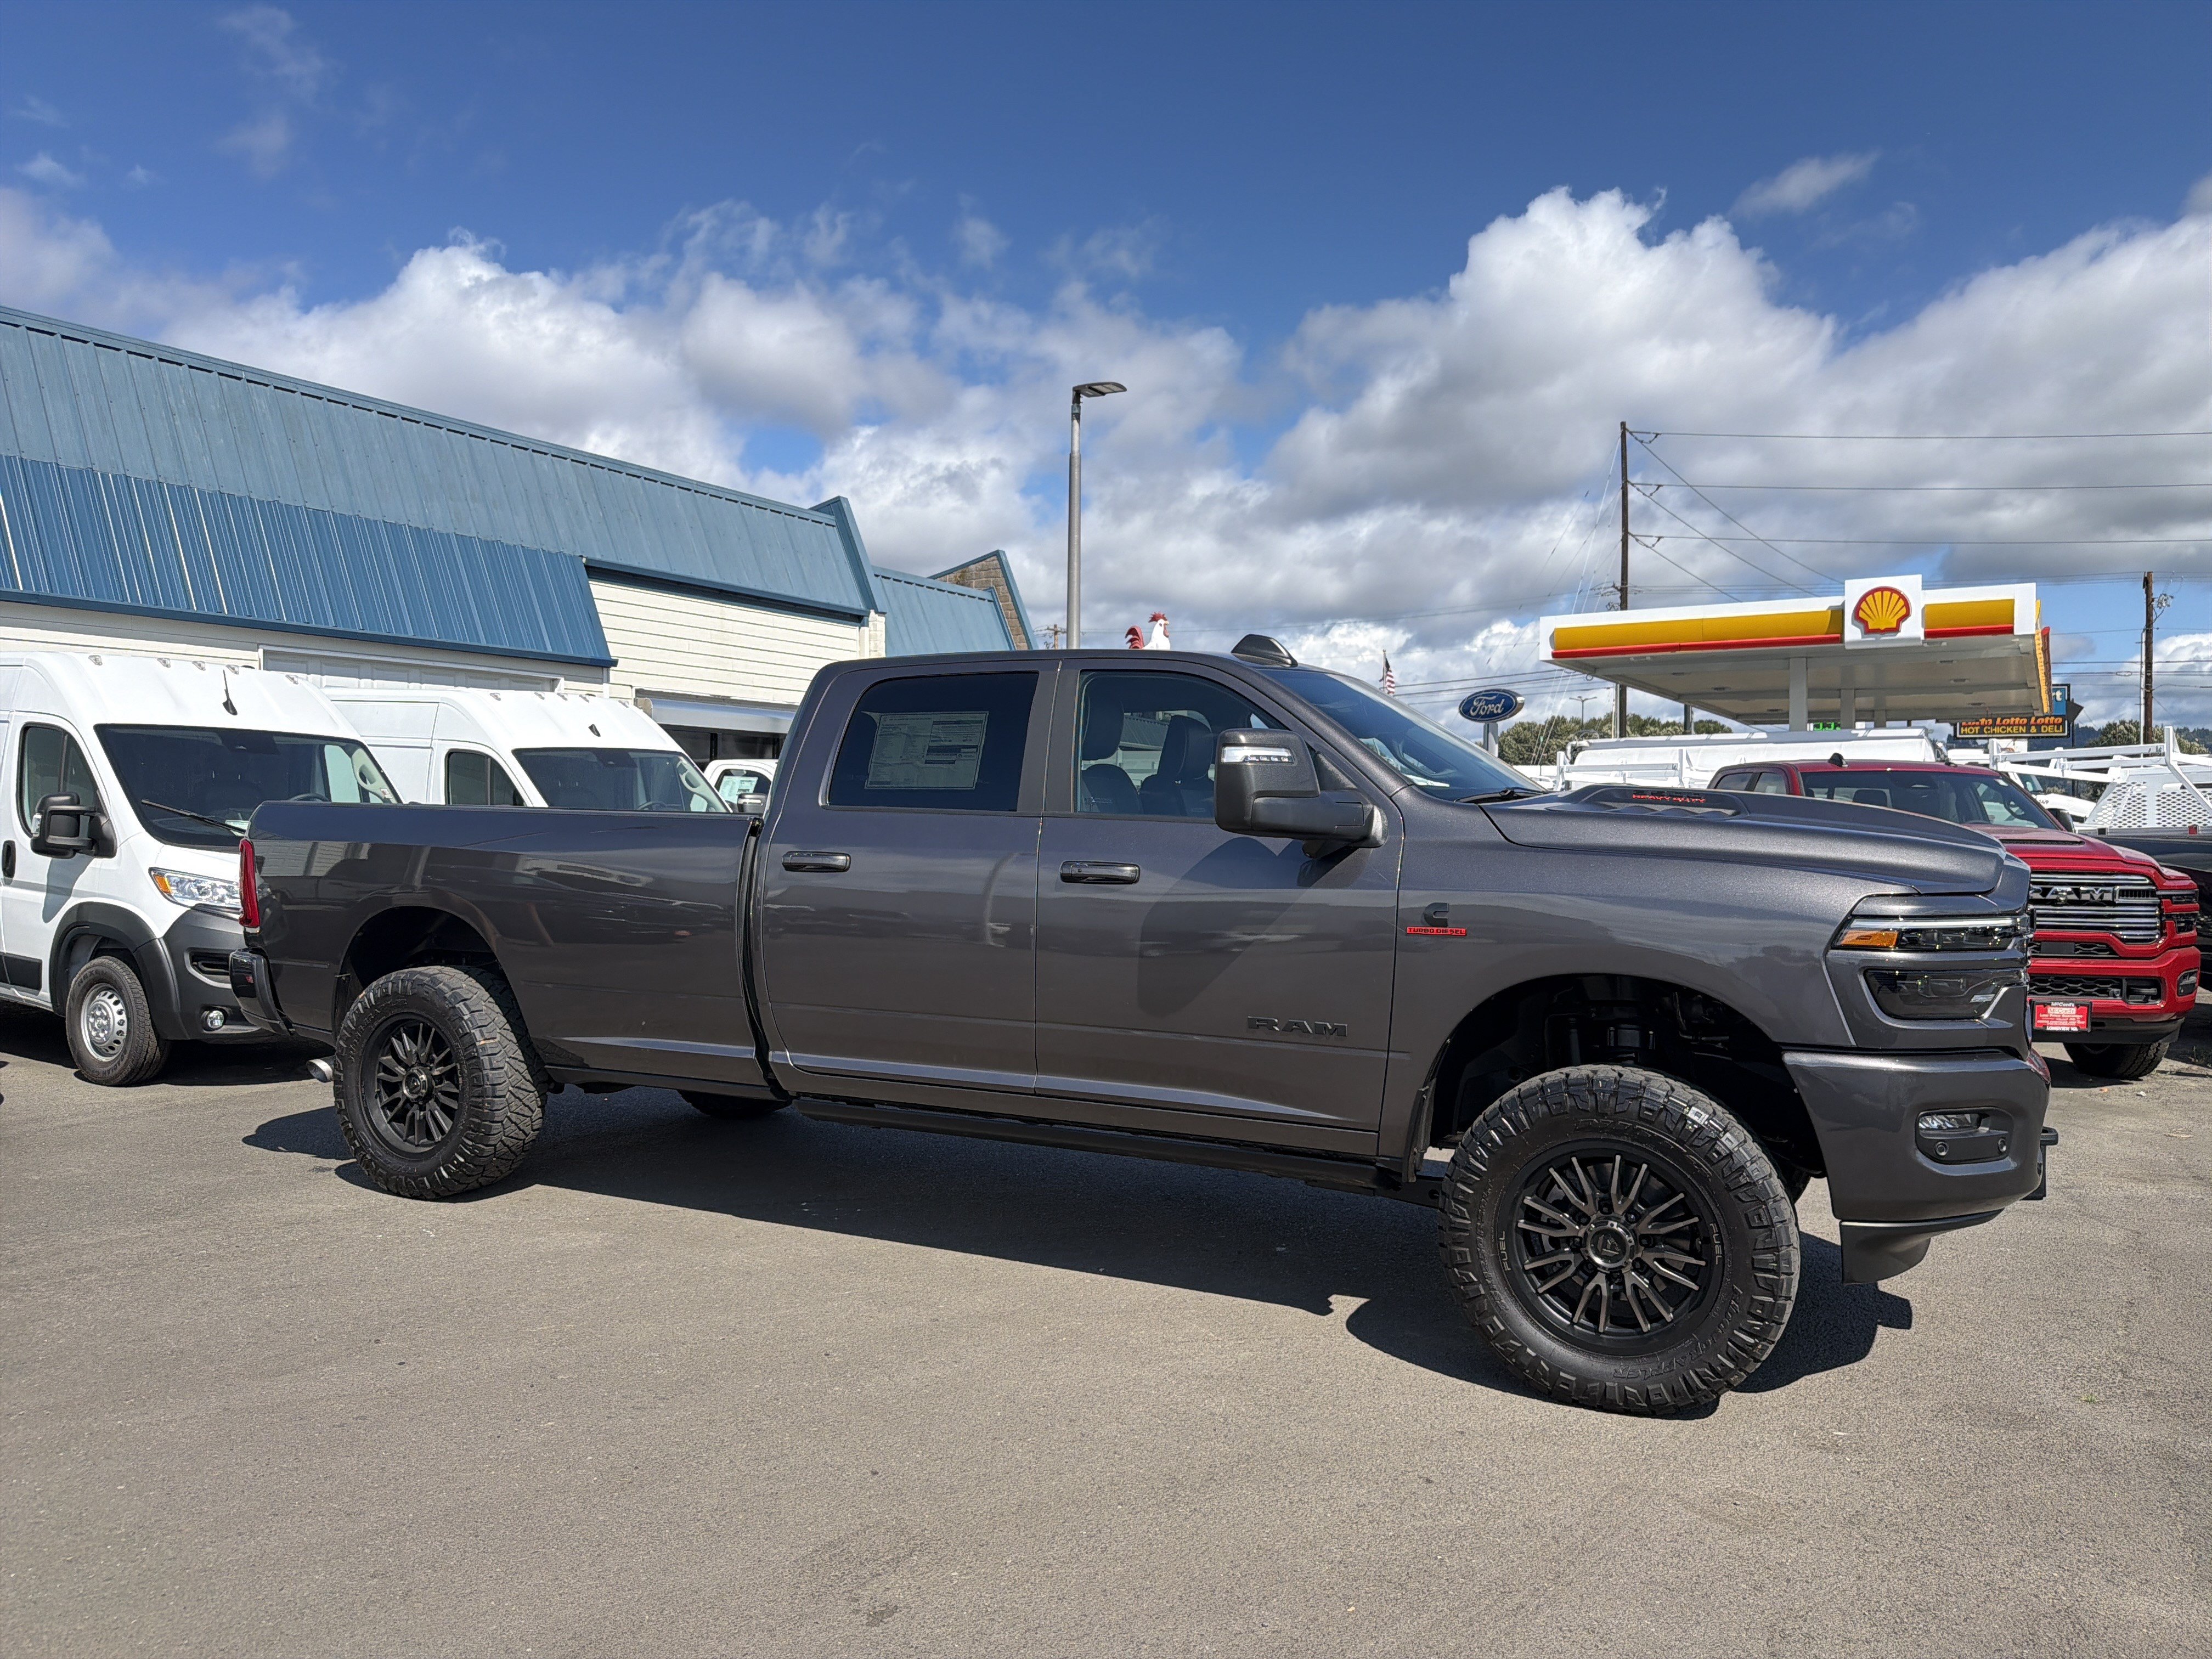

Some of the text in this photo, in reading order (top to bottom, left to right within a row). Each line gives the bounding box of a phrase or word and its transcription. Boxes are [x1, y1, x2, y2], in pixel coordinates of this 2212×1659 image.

[1470, 695, 1505, 716] Ford
[1983, 726, 2026, 734] CHICKEN
[1996, 717, 2028, 725] Lotto
[2030, 716, 2063, 725] Lotto
[1248, 1016, 1348, 1037] RAM
[1499, 1231, 1511, 1271] FUEL
[1709, 1223, 1723, 1265] FUEL
